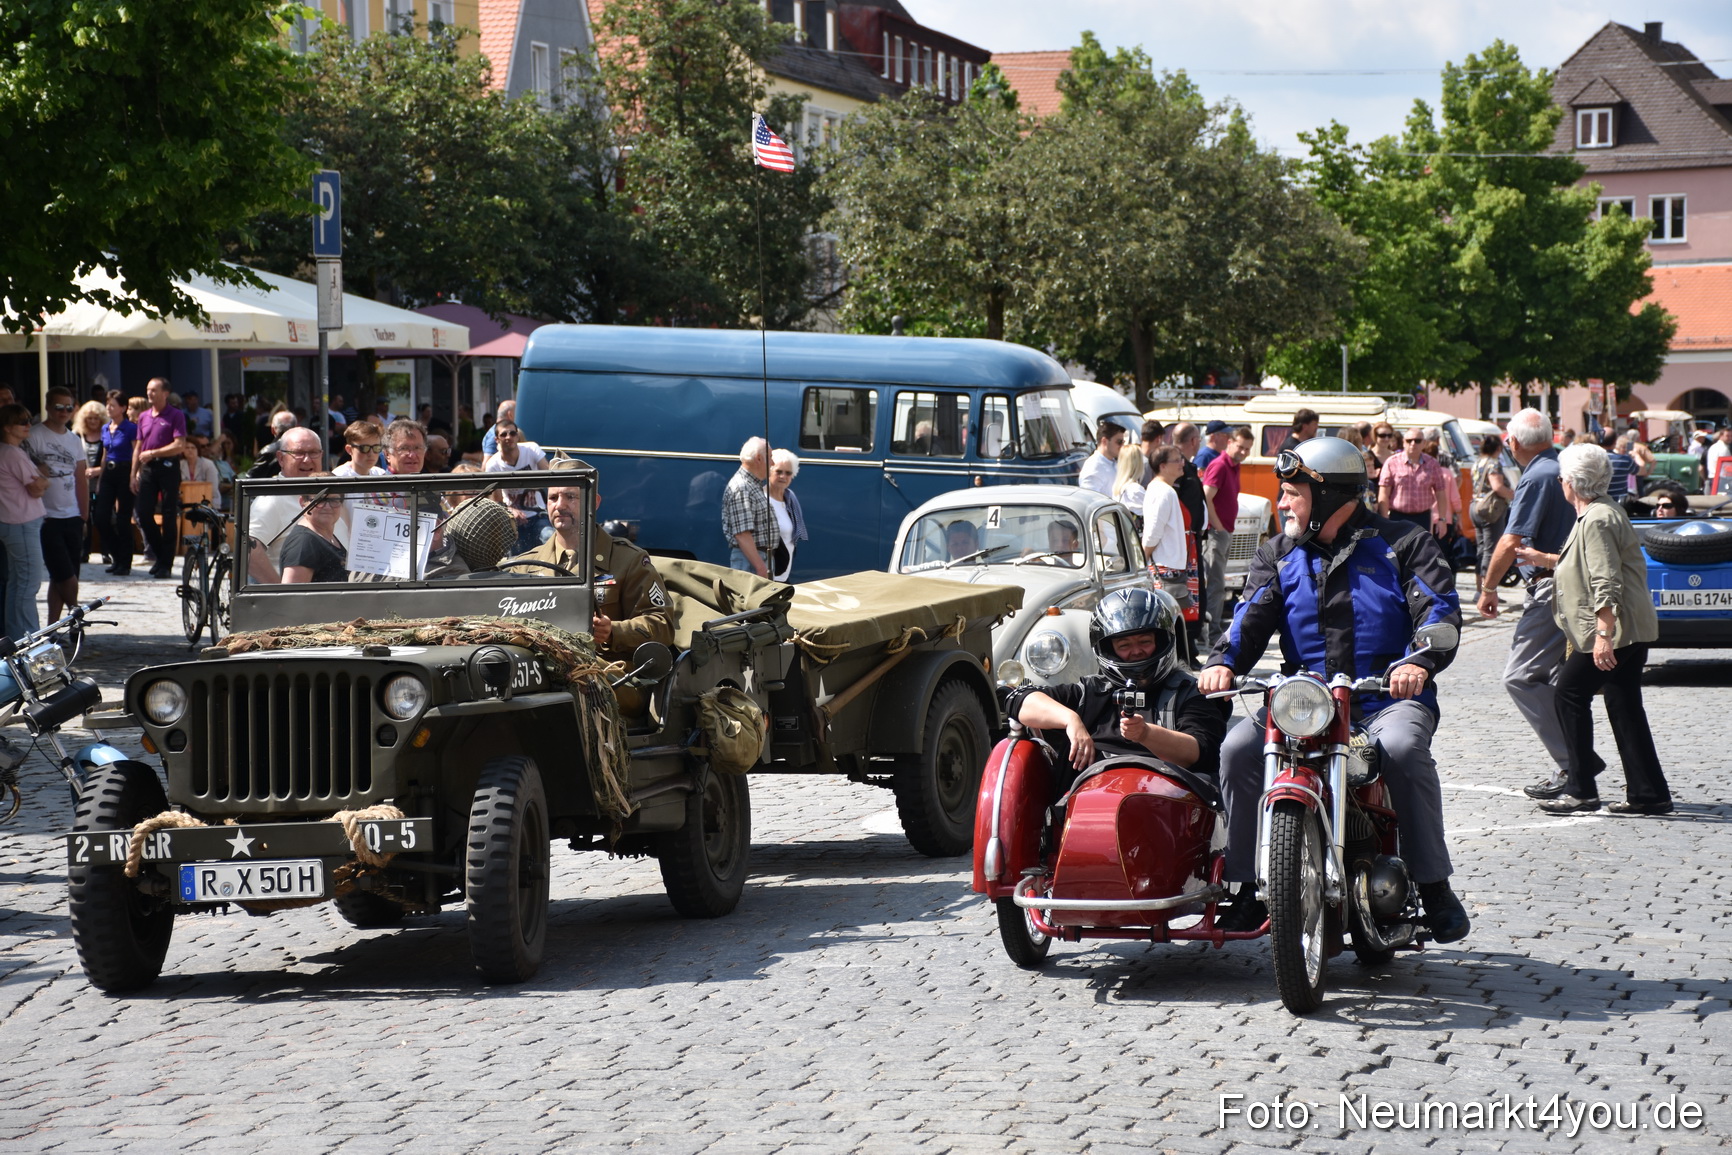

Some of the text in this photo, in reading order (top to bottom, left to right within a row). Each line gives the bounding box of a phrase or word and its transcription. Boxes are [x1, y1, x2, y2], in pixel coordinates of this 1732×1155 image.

[320, 182, 334, 245] P
[374, 328, 396, 341] Tucher
[989, 508, 999, 526] 4
[498, 591, 558, 618] Francis
[1661, 593, 1685, 606] LAU
[1694, 593, 1702, 606] G
[185, 886, 192, 896] D
[202, 869, 218, 896] R
[237, 868, 253, 895] X
